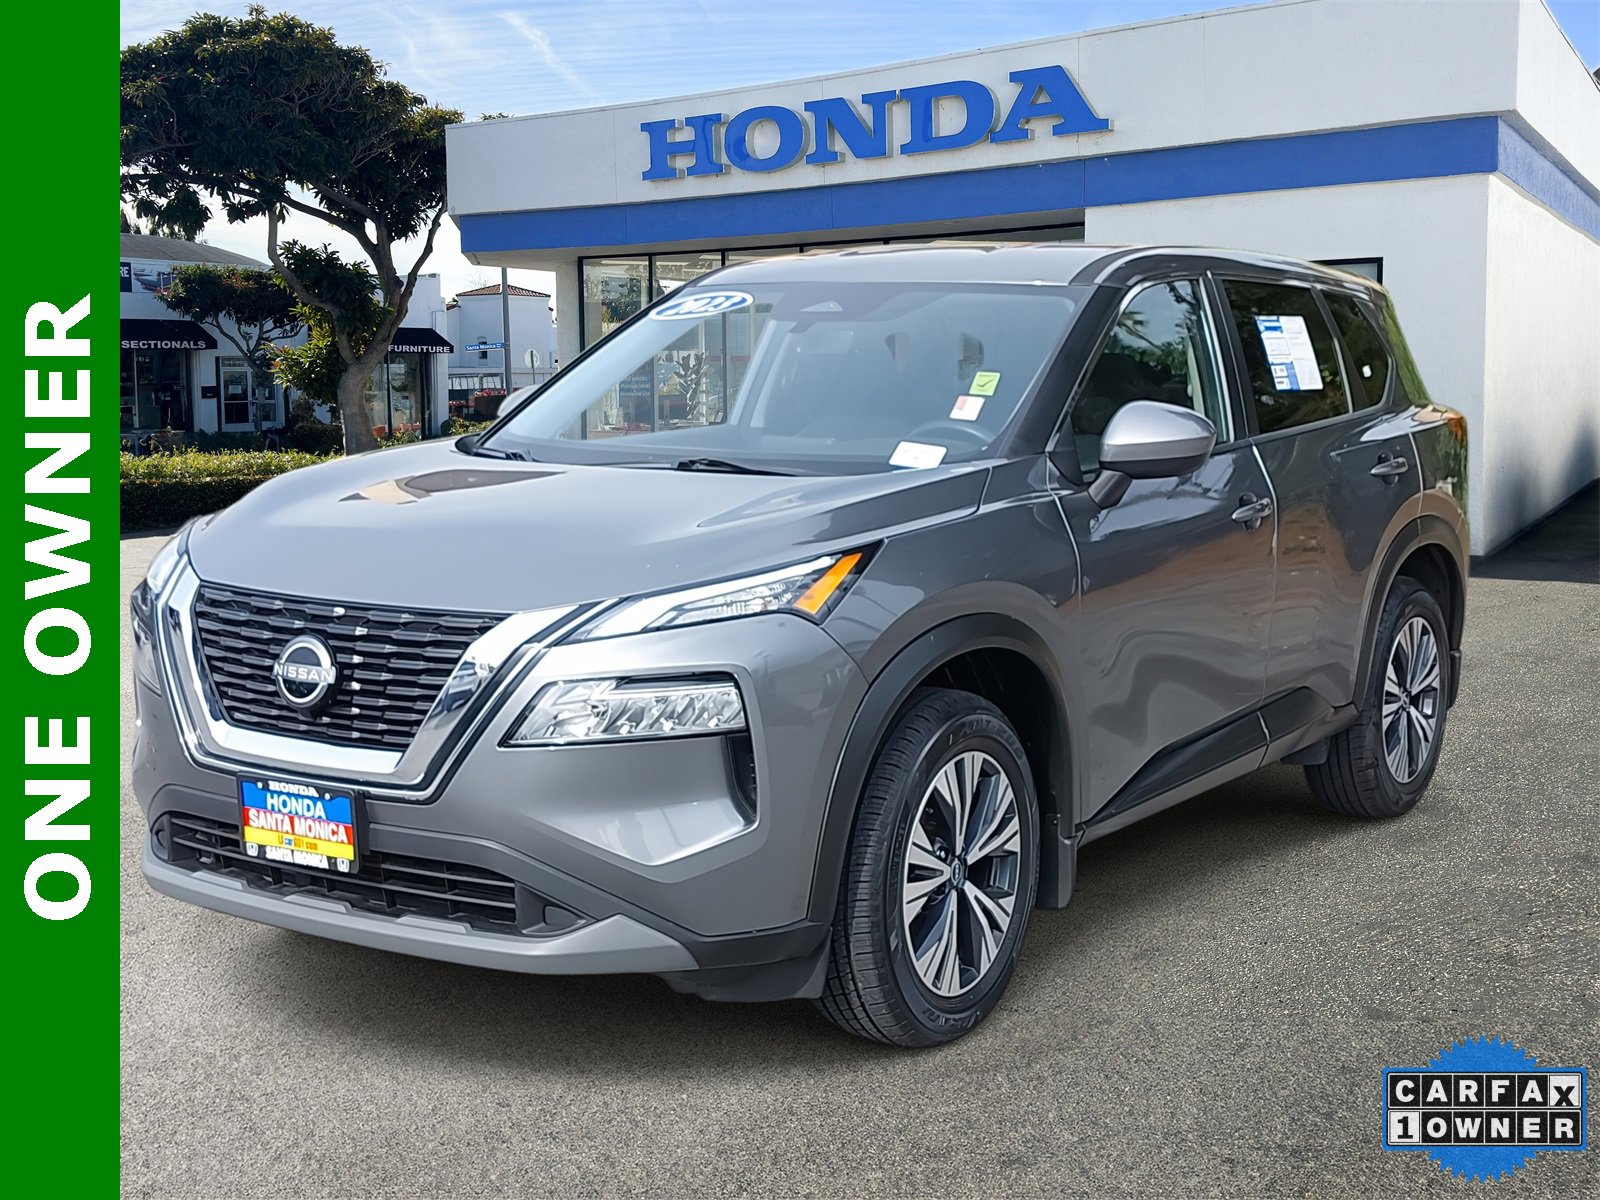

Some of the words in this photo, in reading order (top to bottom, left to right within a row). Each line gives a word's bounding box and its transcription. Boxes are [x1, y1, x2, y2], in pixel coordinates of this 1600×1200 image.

[640, 64, 1111, 182] HONDA
[121, 340, 206, 349] SECTIONALS
[388, 344, 450, 353] FURNITURE
[273, 661, 333, 683] NISSAN
[268, 781, 320, 797] HONDA
[266, 793, 327, 819] HONDA
[248, 809, 293, 834] SANTA
[293, 816, 349, 844] MONICA
